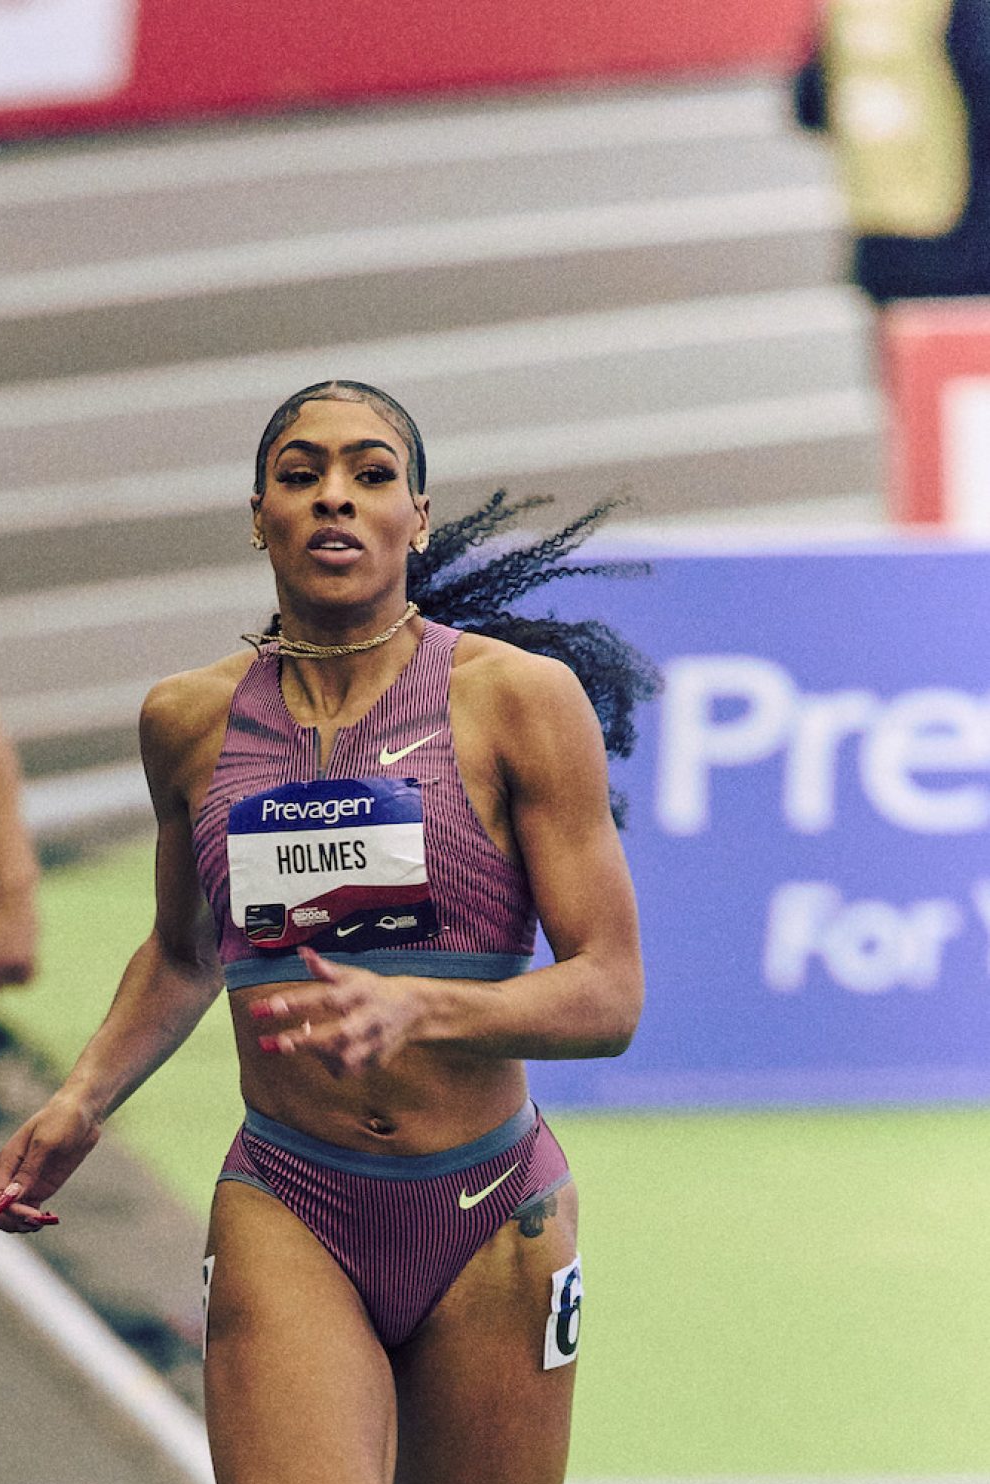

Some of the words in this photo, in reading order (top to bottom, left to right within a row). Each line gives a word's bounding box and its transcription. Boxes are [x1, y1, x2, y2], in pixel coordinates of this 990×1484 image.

[262, 797, 372, 825] Prevagen
[276, 840, 367, 875] HOLMES
[556, 1266, 581, 1356] 6
